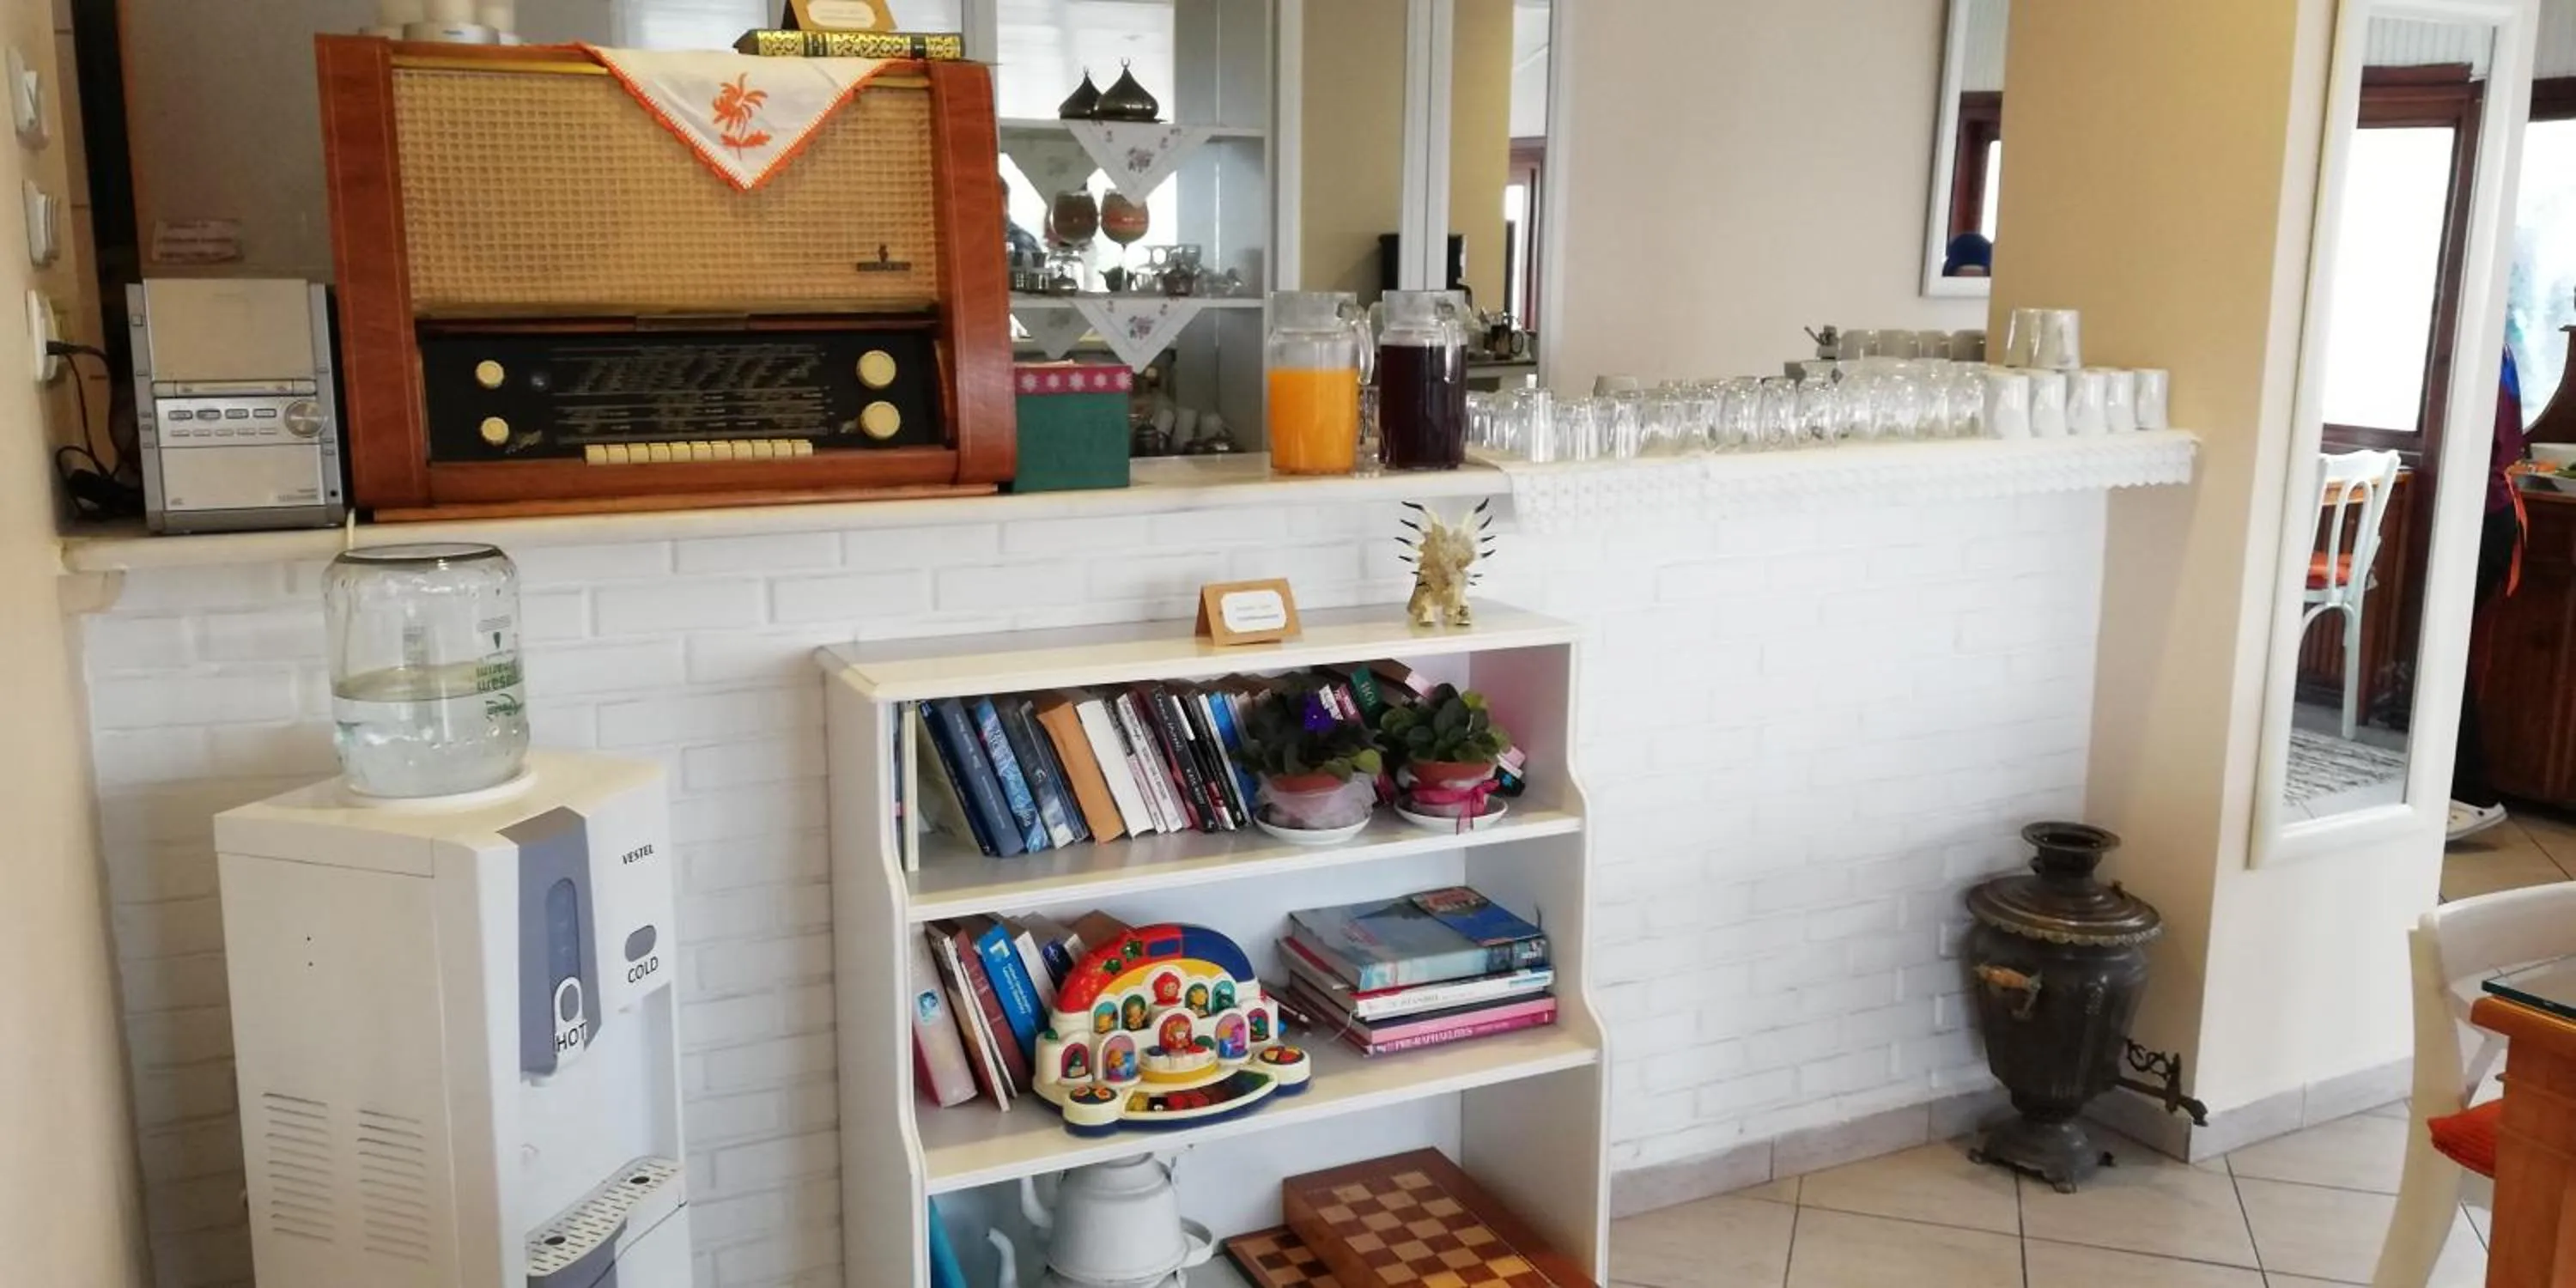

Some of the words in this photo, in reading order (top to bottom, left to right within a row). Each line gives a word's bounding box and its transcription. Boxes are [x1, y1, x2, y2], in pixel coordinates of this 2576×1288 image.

[622, 844, 654, 865] VESTEL
[628, 956, 659, 983] COLD
[556, 1019, 587, 1052] HOT
